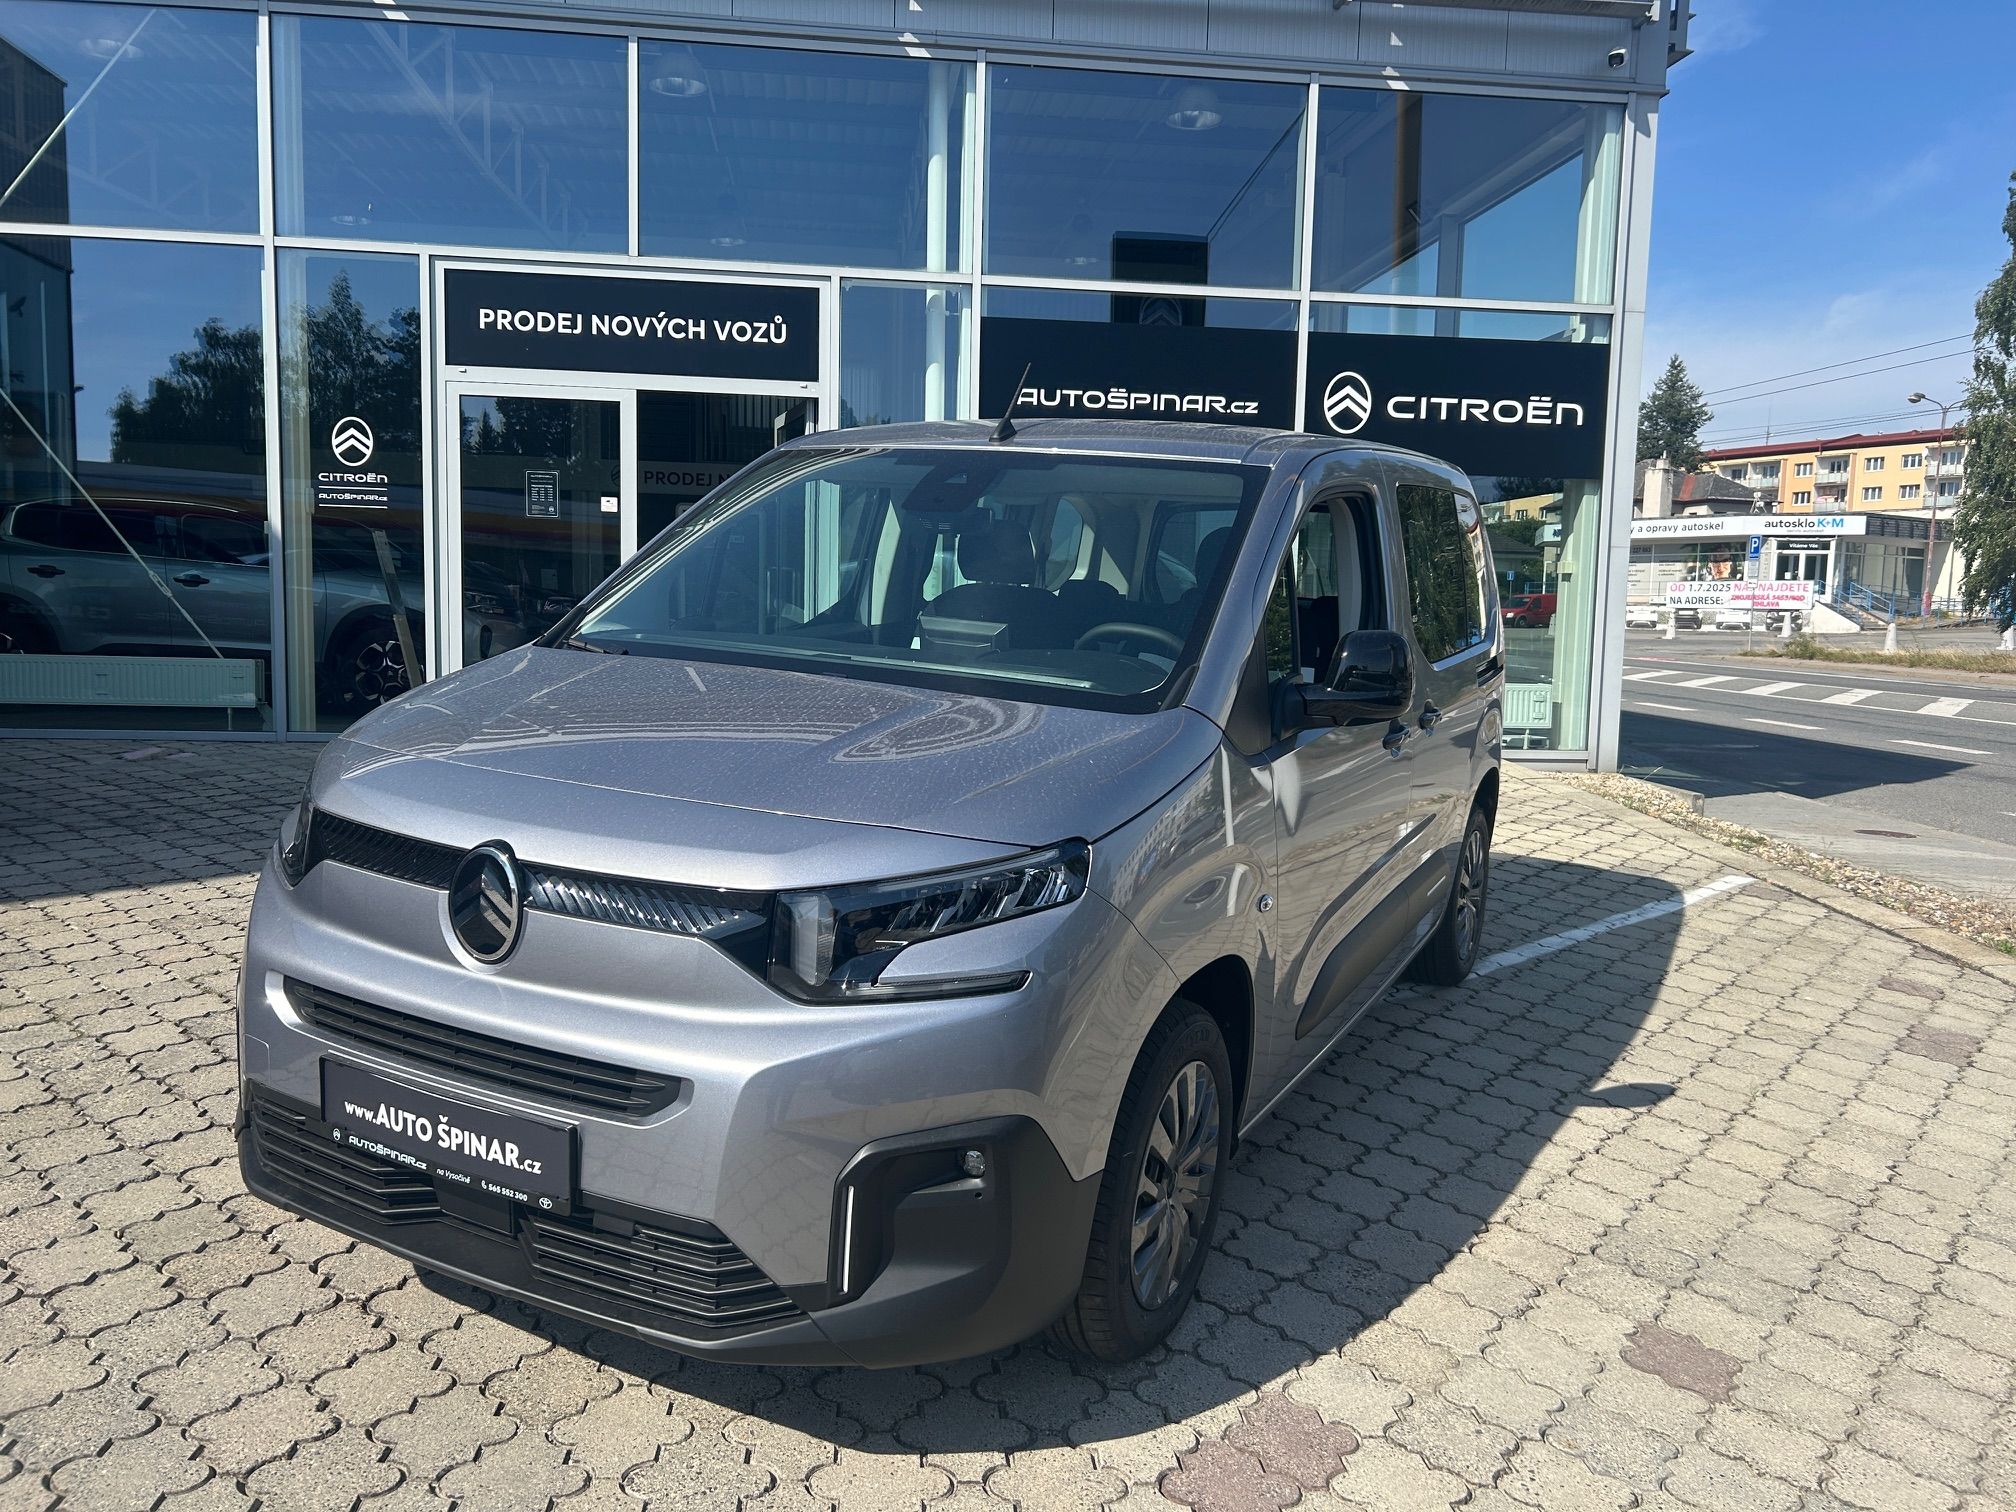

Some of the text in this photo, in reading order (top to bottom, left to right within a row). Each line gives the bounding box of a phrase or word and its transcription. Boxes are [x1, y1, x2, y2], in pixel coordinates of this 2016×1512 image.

[479, 308, 787, 344] PRODEJ NOVÝCH VOZŮ
[1016, 388, 1258, 414] AUTOŠPINAR.cz
[1387, 396, 1583, 426] CITROËN
[318, 472, 388, 483] CITROËN
[643, 471, 712, 487] PRODEJ
[1646, 524, 1678, 534] opravy
[1681, 521, 1724, 532] autoskel
[1764, 518, 1844, 528] autosklo K+M
[1751, 538, 1759, 553] P
[1670, 584, 1685, 592] OD
[1689, 584, 1731, 592] 1.7.2025
[1758, 583, 1809, 592] NAJDETE
[1670, 596, 1723, 605] NA ADRESE:
[344, 1101, 542, 1175] www.AUTO ŠPINAR.cz
[437, 1168, 444, 1176] na
[488, 1184, 528, 1201] 565 552 300
